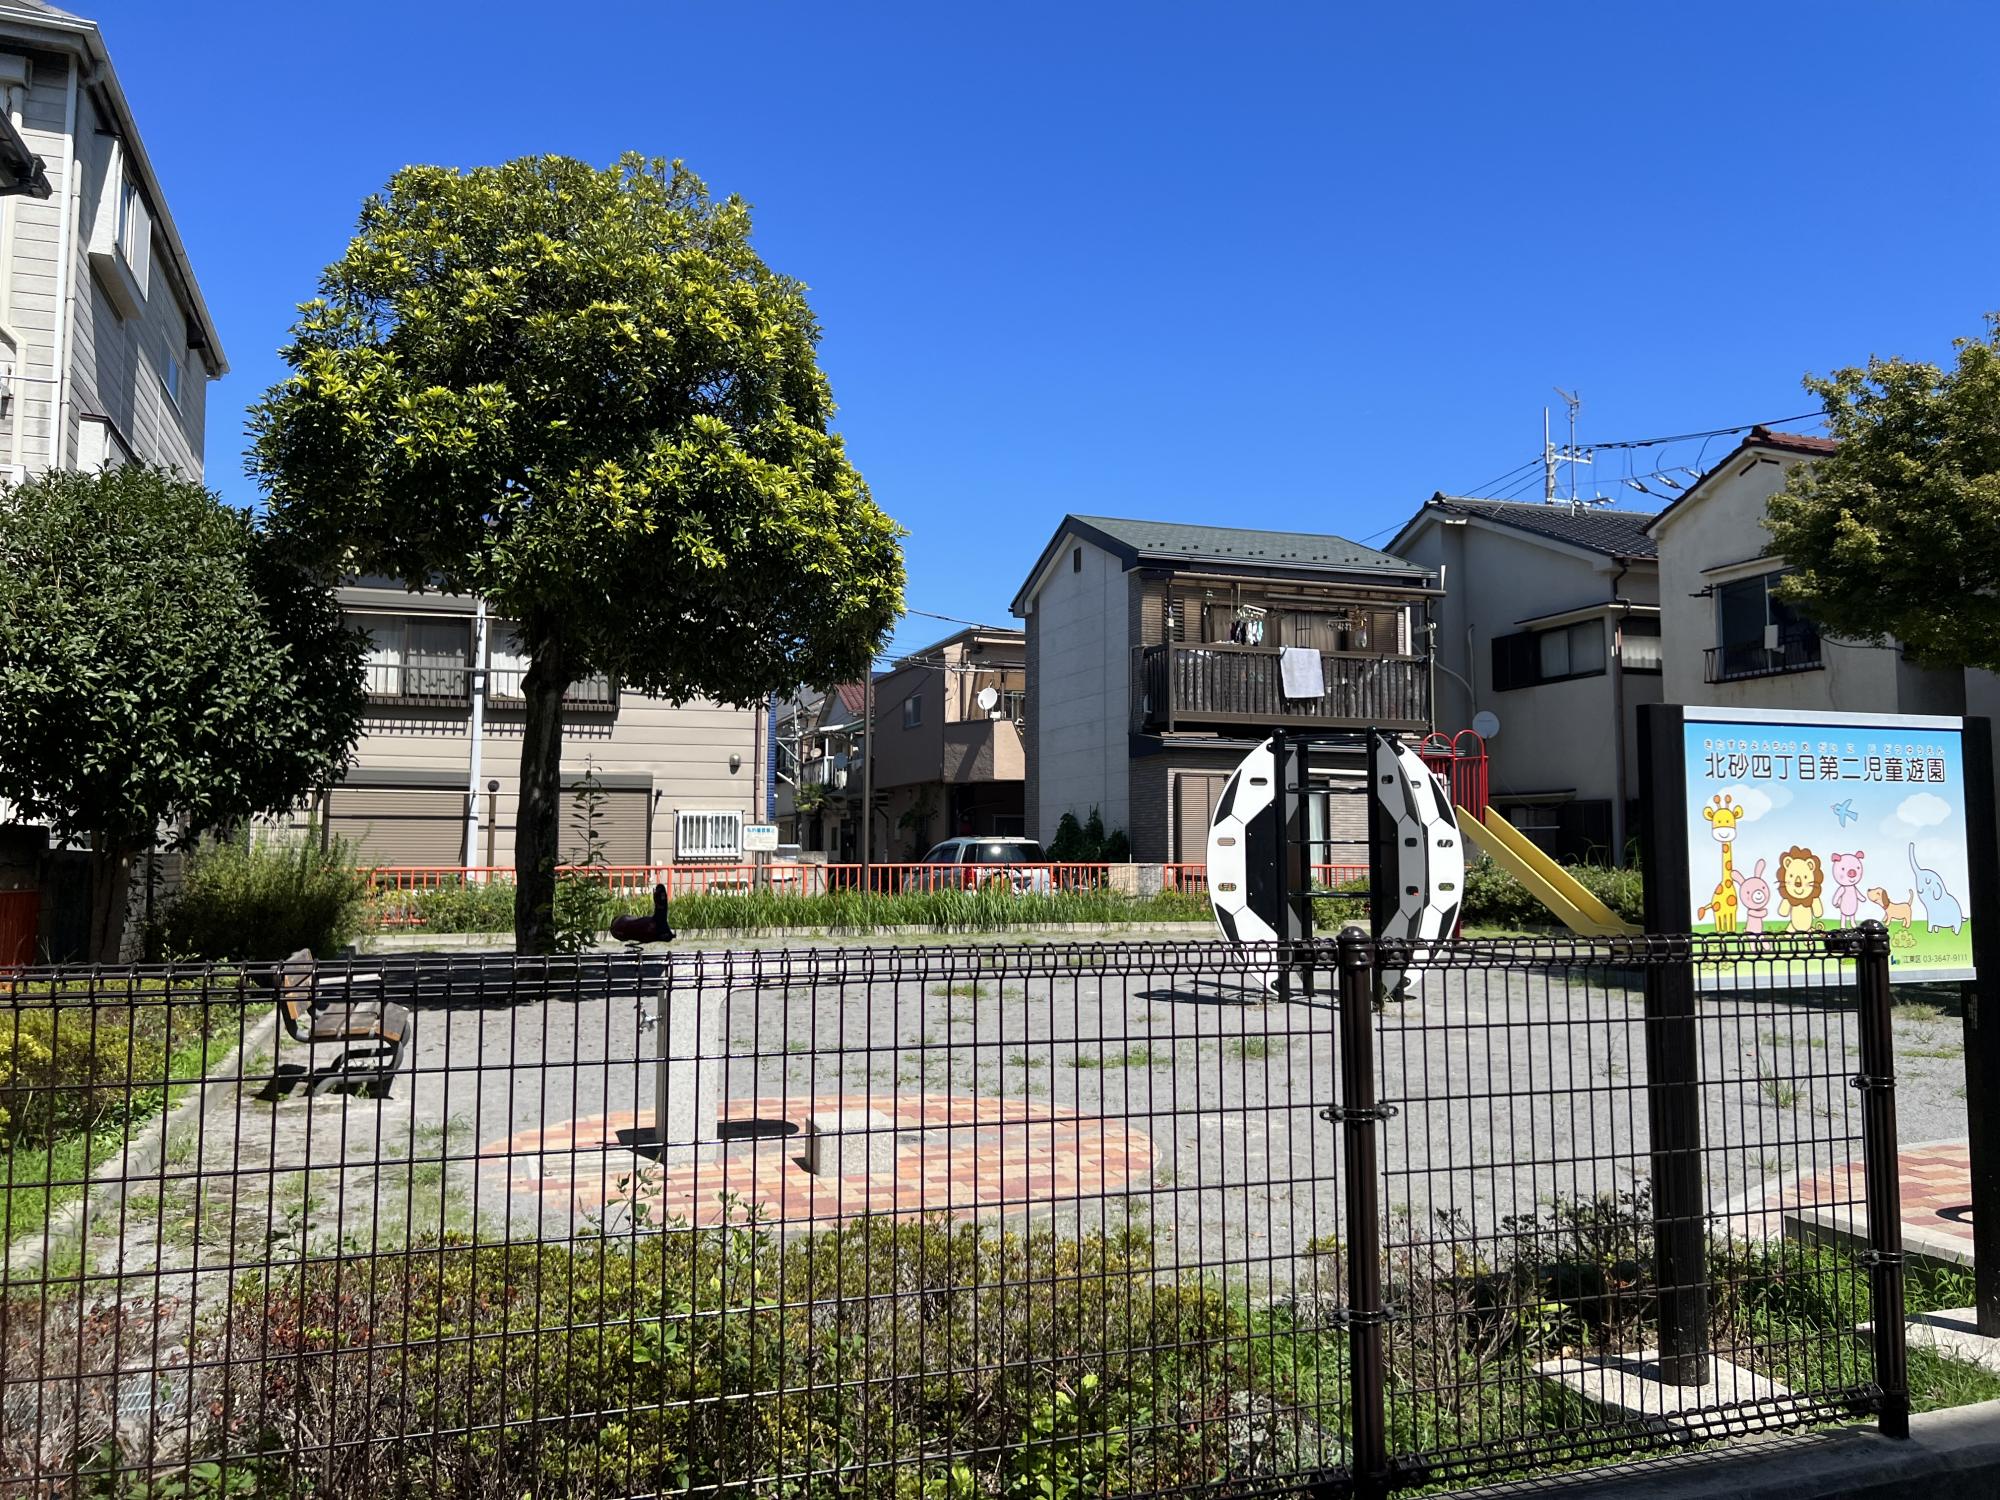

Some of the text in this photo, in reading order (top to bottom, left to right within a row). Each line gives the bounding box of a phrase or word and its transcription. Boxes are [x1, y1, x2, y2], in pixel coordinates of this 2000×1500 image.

[1705, 752, 1945, 783] 北砂四丁目第二児童遊園
[1922, 954, 1968, 963] 03-3647-9111
